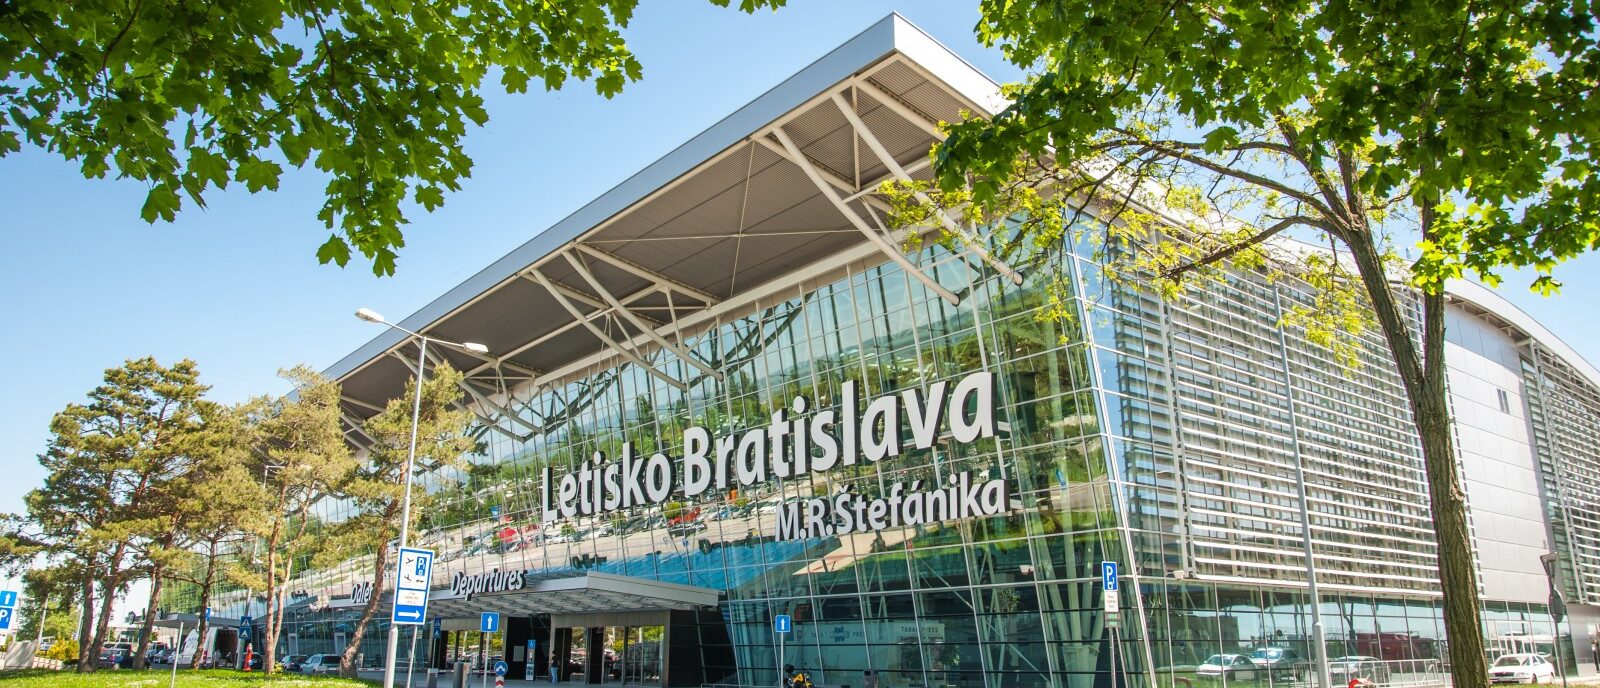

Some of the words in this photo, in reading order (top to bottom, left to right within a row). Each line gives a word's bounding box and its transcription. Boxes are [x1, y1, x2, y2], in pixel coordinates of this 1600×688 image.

[542, 441, 673, 523] Letisko
[683, 371, 995, 498] Bratislava
[351, 582, 374, 603] Odlet
[450, 568, 525, 601] Departures
